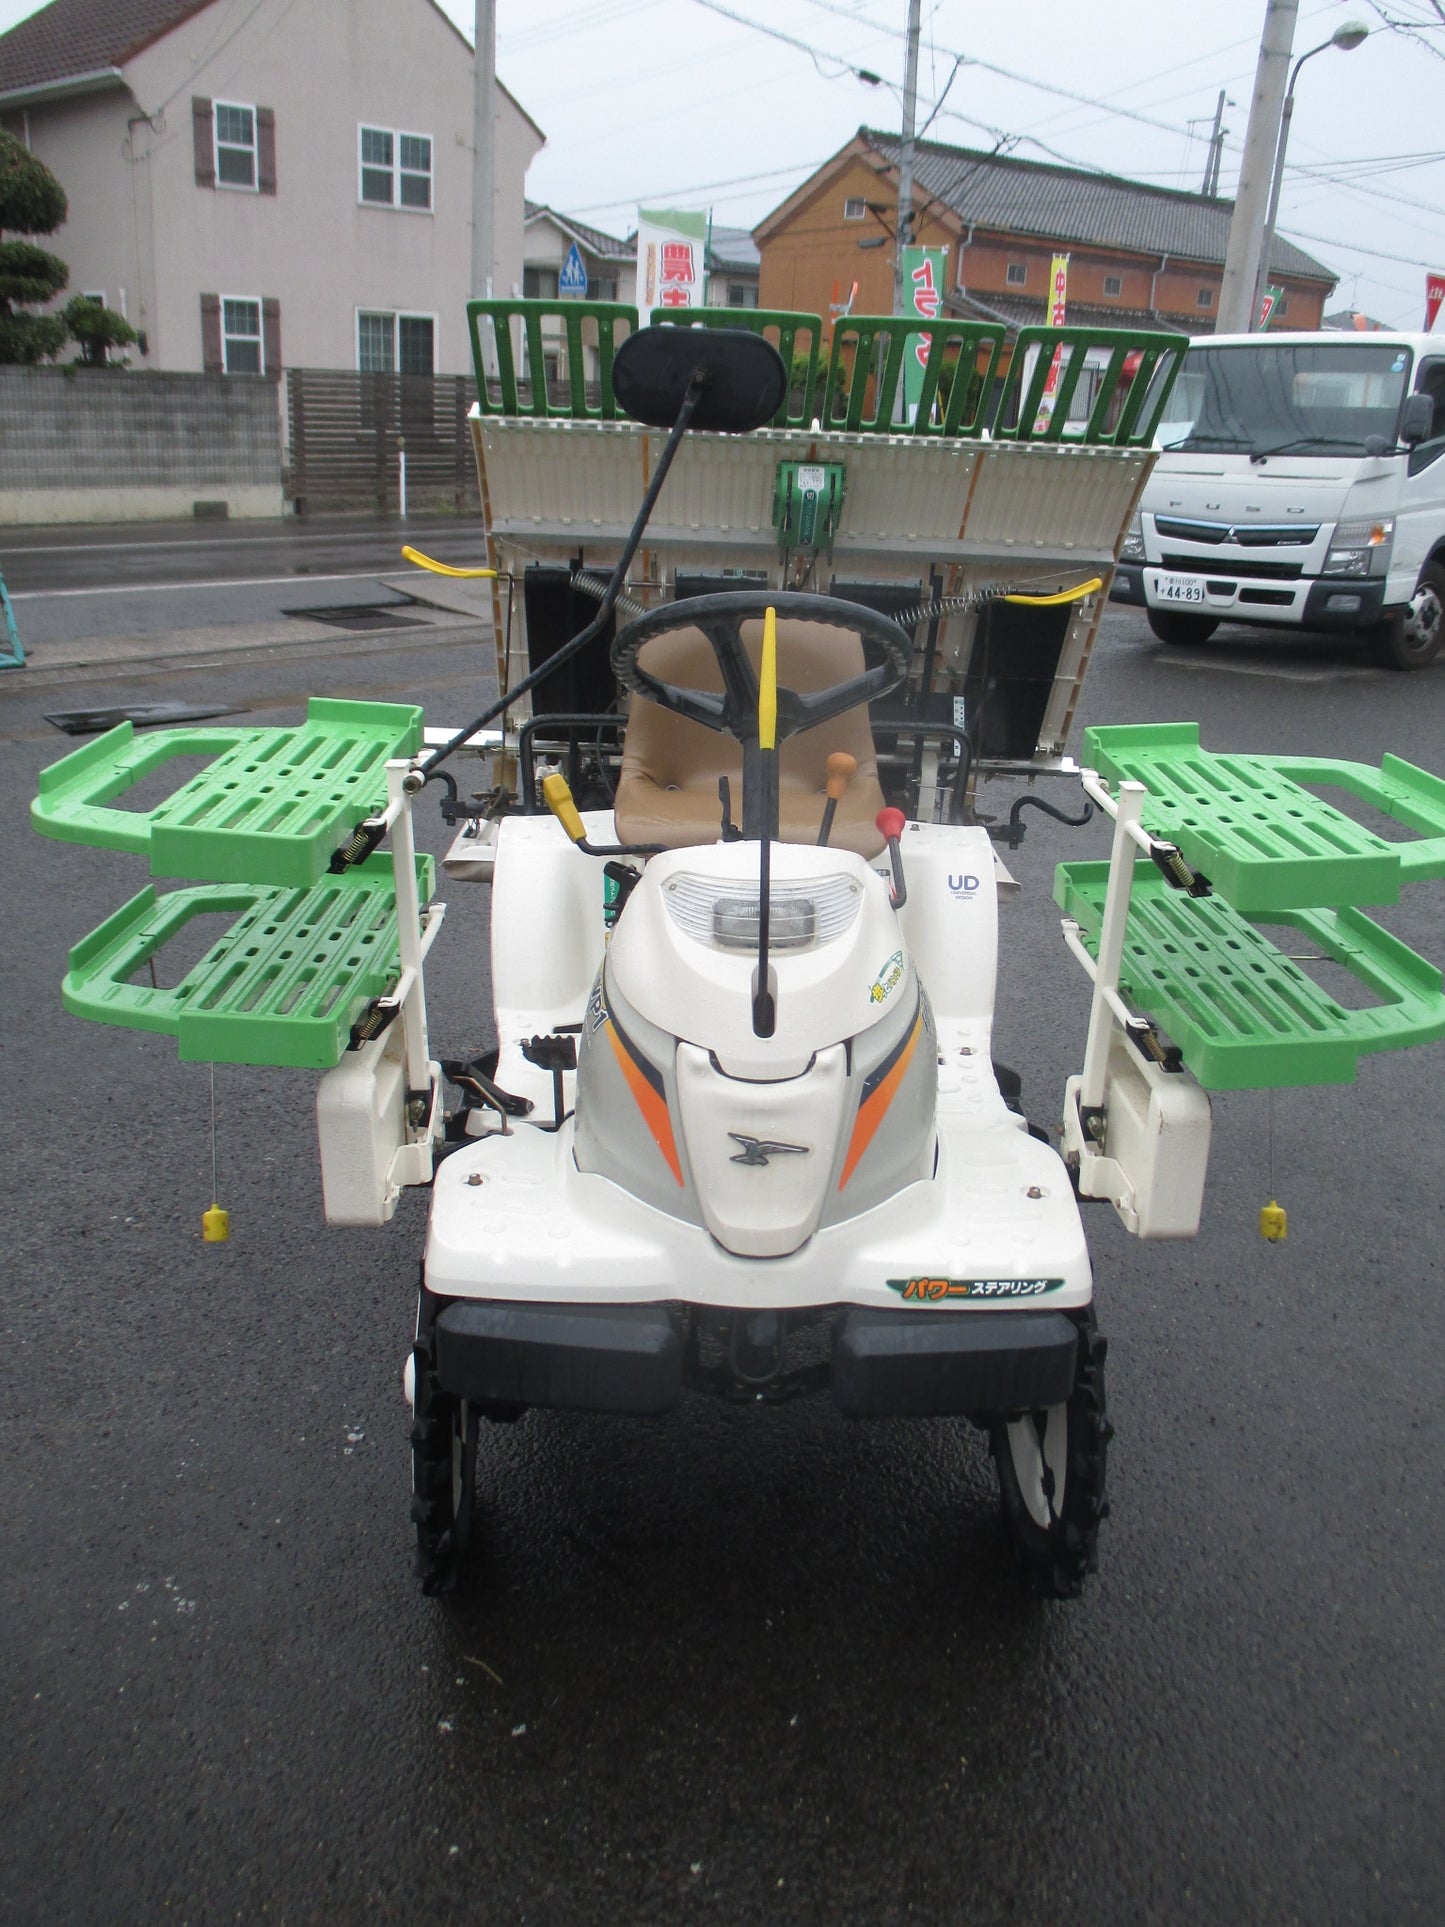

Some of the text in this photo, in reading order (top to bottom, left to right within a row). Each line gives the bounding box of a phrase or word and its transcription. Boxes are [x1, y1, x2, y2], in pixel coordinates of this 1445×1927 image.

[1169, 500, 1304, 514] FUSO
[1167, 586, 1201, 601] 44-89
[947, 874, 980, 891] UD
[902, 1279, 1048, 1299] パワー ステアリング
